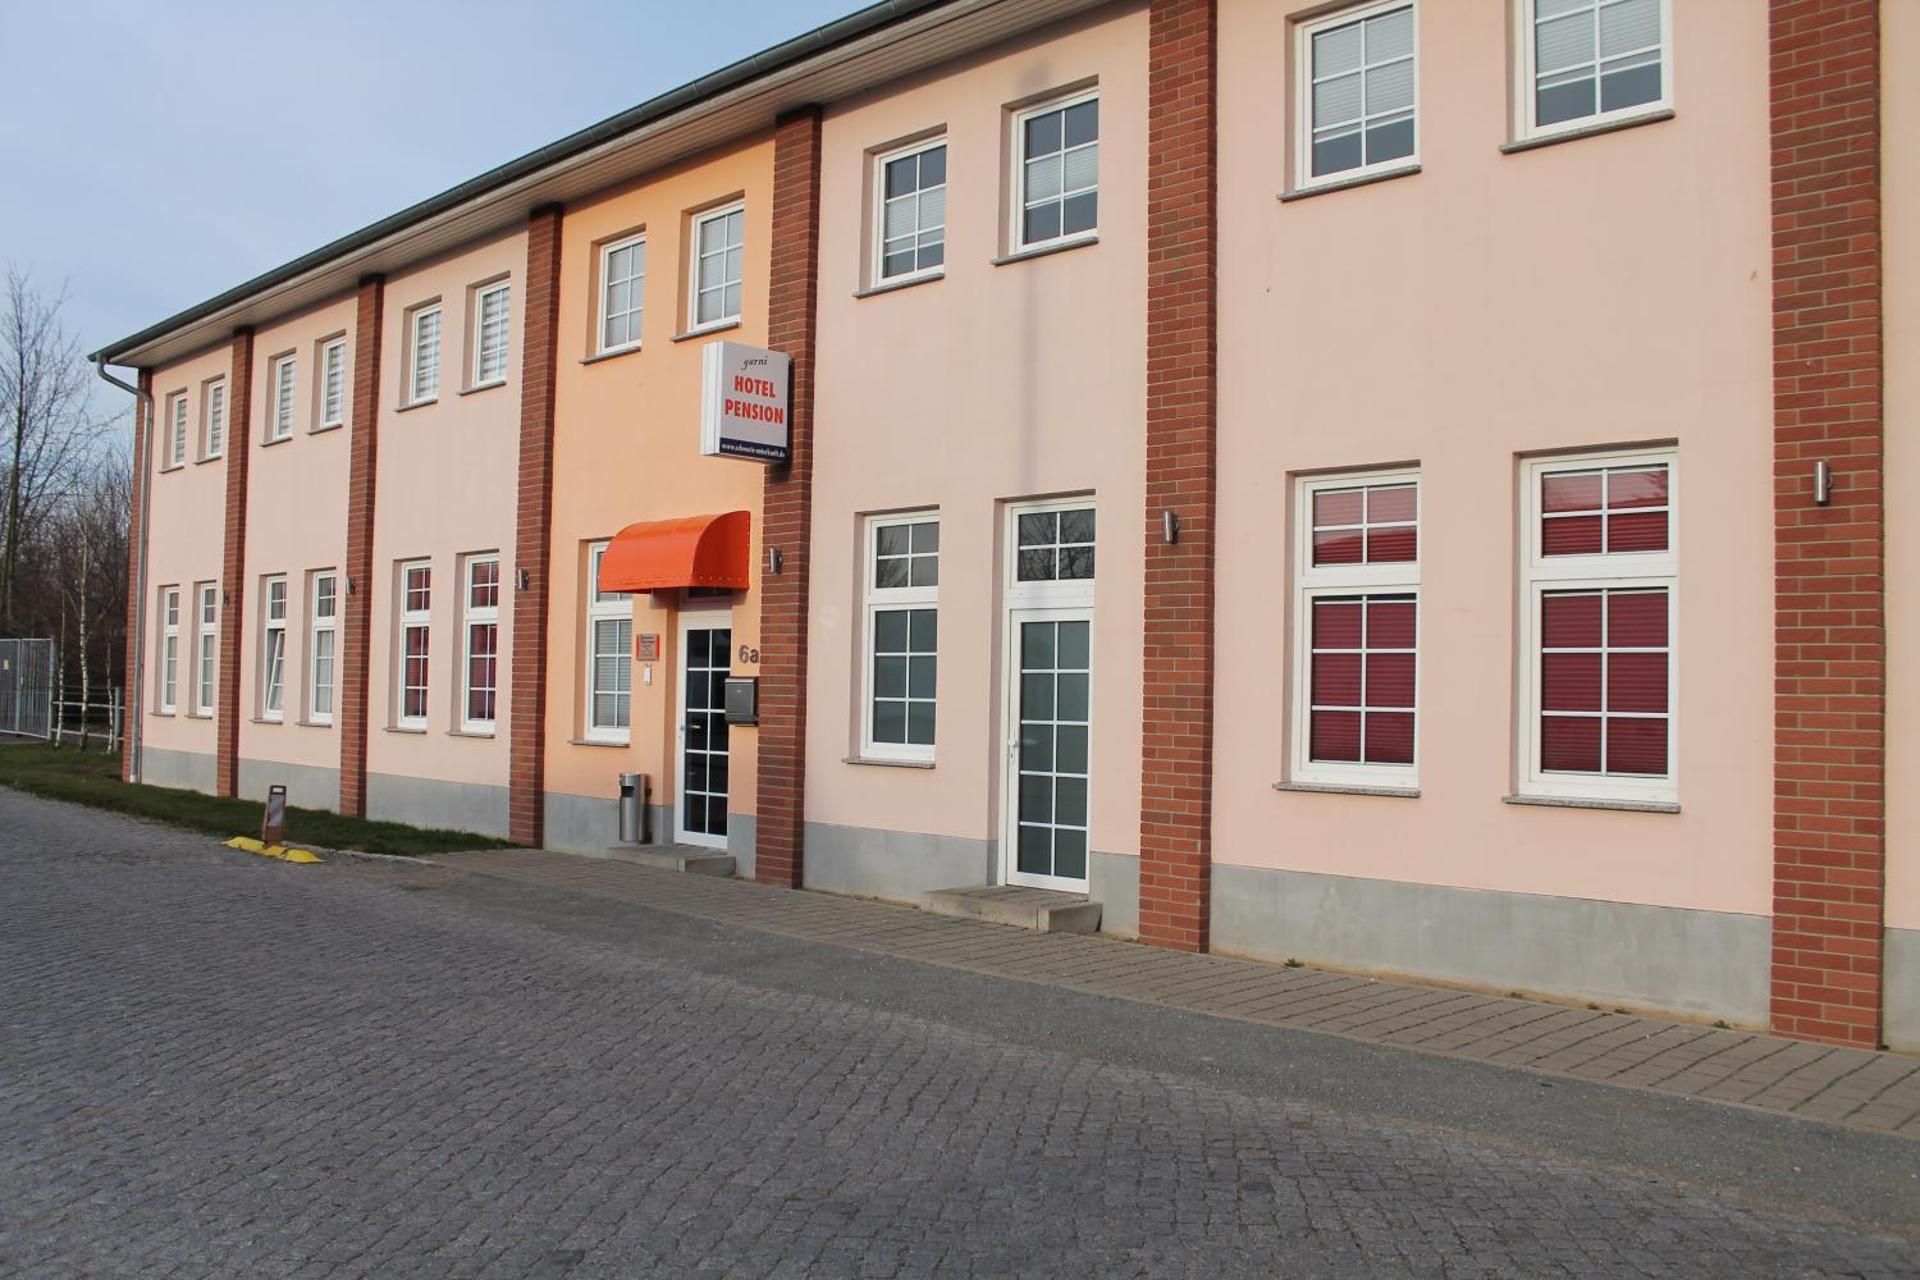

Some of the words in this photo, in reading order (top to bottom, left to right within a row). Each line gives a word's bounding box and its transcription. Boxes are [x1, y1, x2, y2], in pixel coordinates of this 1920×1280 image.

[742, 355, 768, 371] garni
[734, 375, 776, 398] HOTEL
[725, 399, 784, 424] PENSION
[739, 644, 759, 664] 6a
